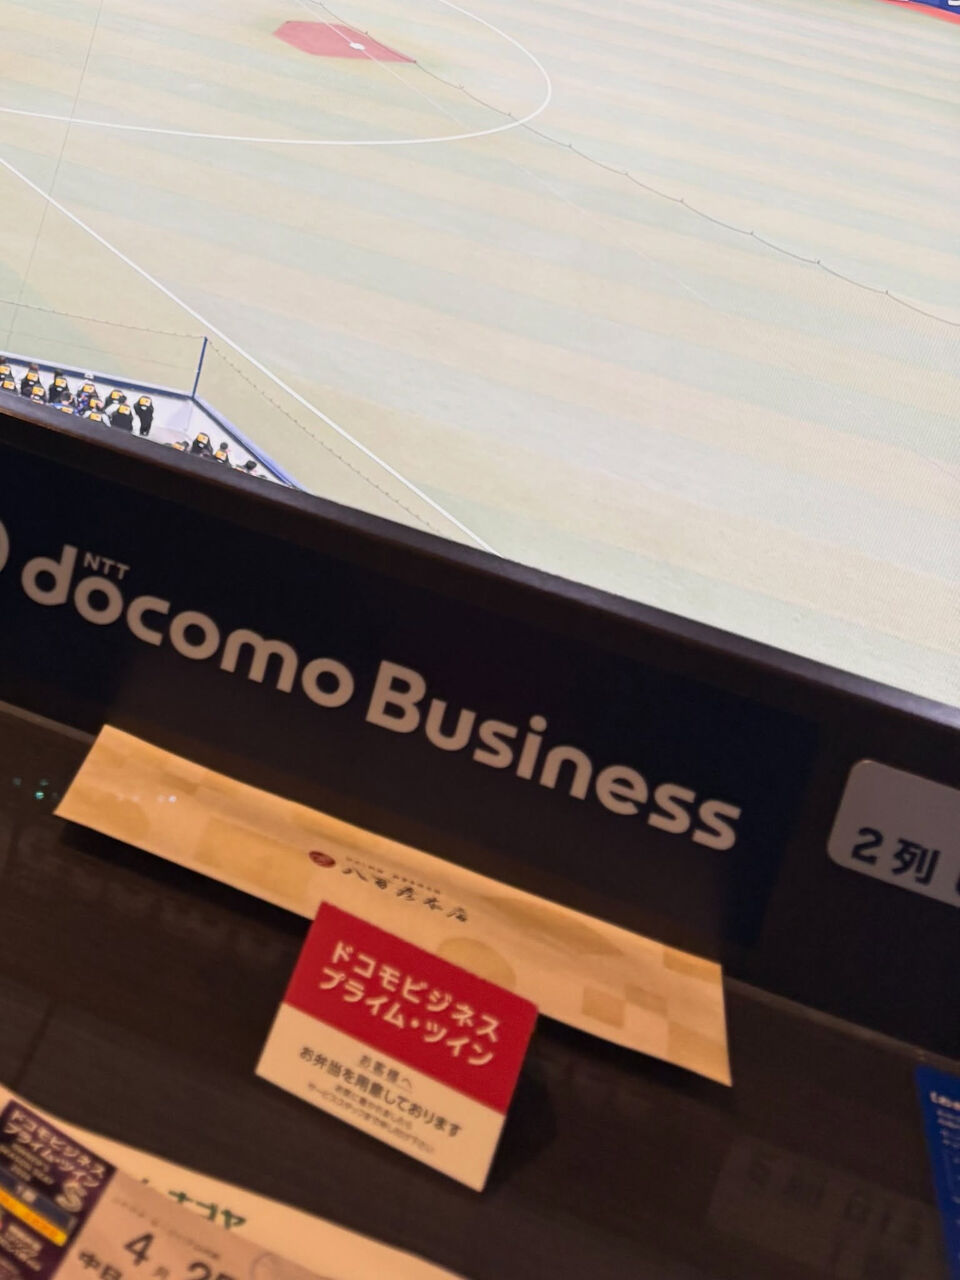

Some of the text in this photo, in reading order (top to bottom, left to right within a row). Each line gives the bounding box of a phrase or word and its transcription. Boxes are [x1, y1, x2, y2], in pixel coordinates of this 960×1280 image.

[82, 552, 131, 581] NTT
[21, 544, 743, 853] docomo Business
[319, 967, 494, 1066] プライム・ツイン
[332, 941, 499, 1043] ドコモビジネス
[299, 1046, 463, 1138] お弁当を用意しております
